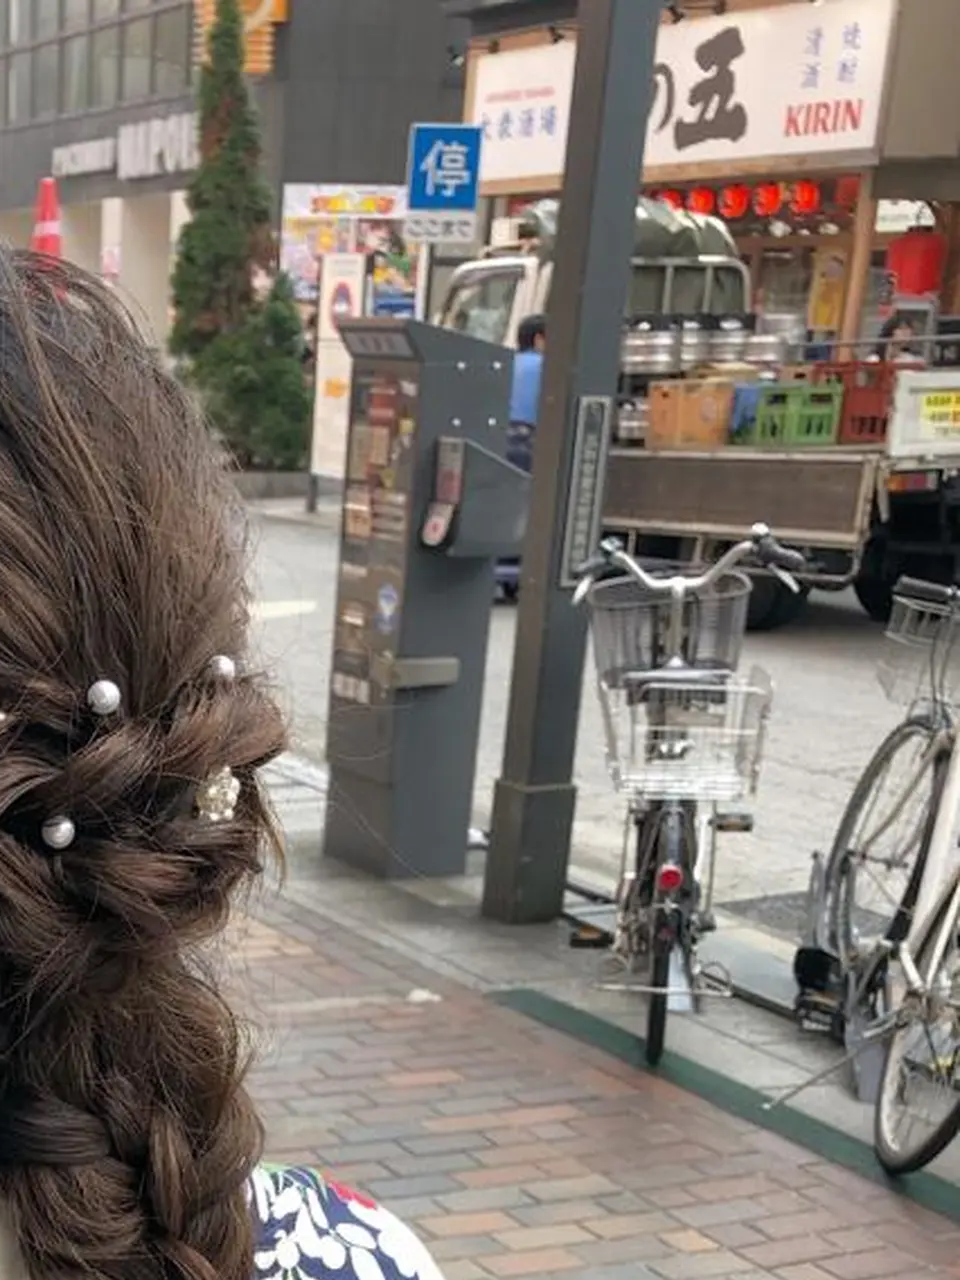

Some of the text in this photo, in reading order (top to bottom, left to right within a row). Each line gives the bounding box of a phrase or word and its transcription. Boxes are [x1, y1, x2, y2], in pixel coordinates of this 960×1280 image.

[783, 99, 864, 137] KIRIN
[419, 139, 472, 197] 停
[407, 217, 473, 239] ここまで
